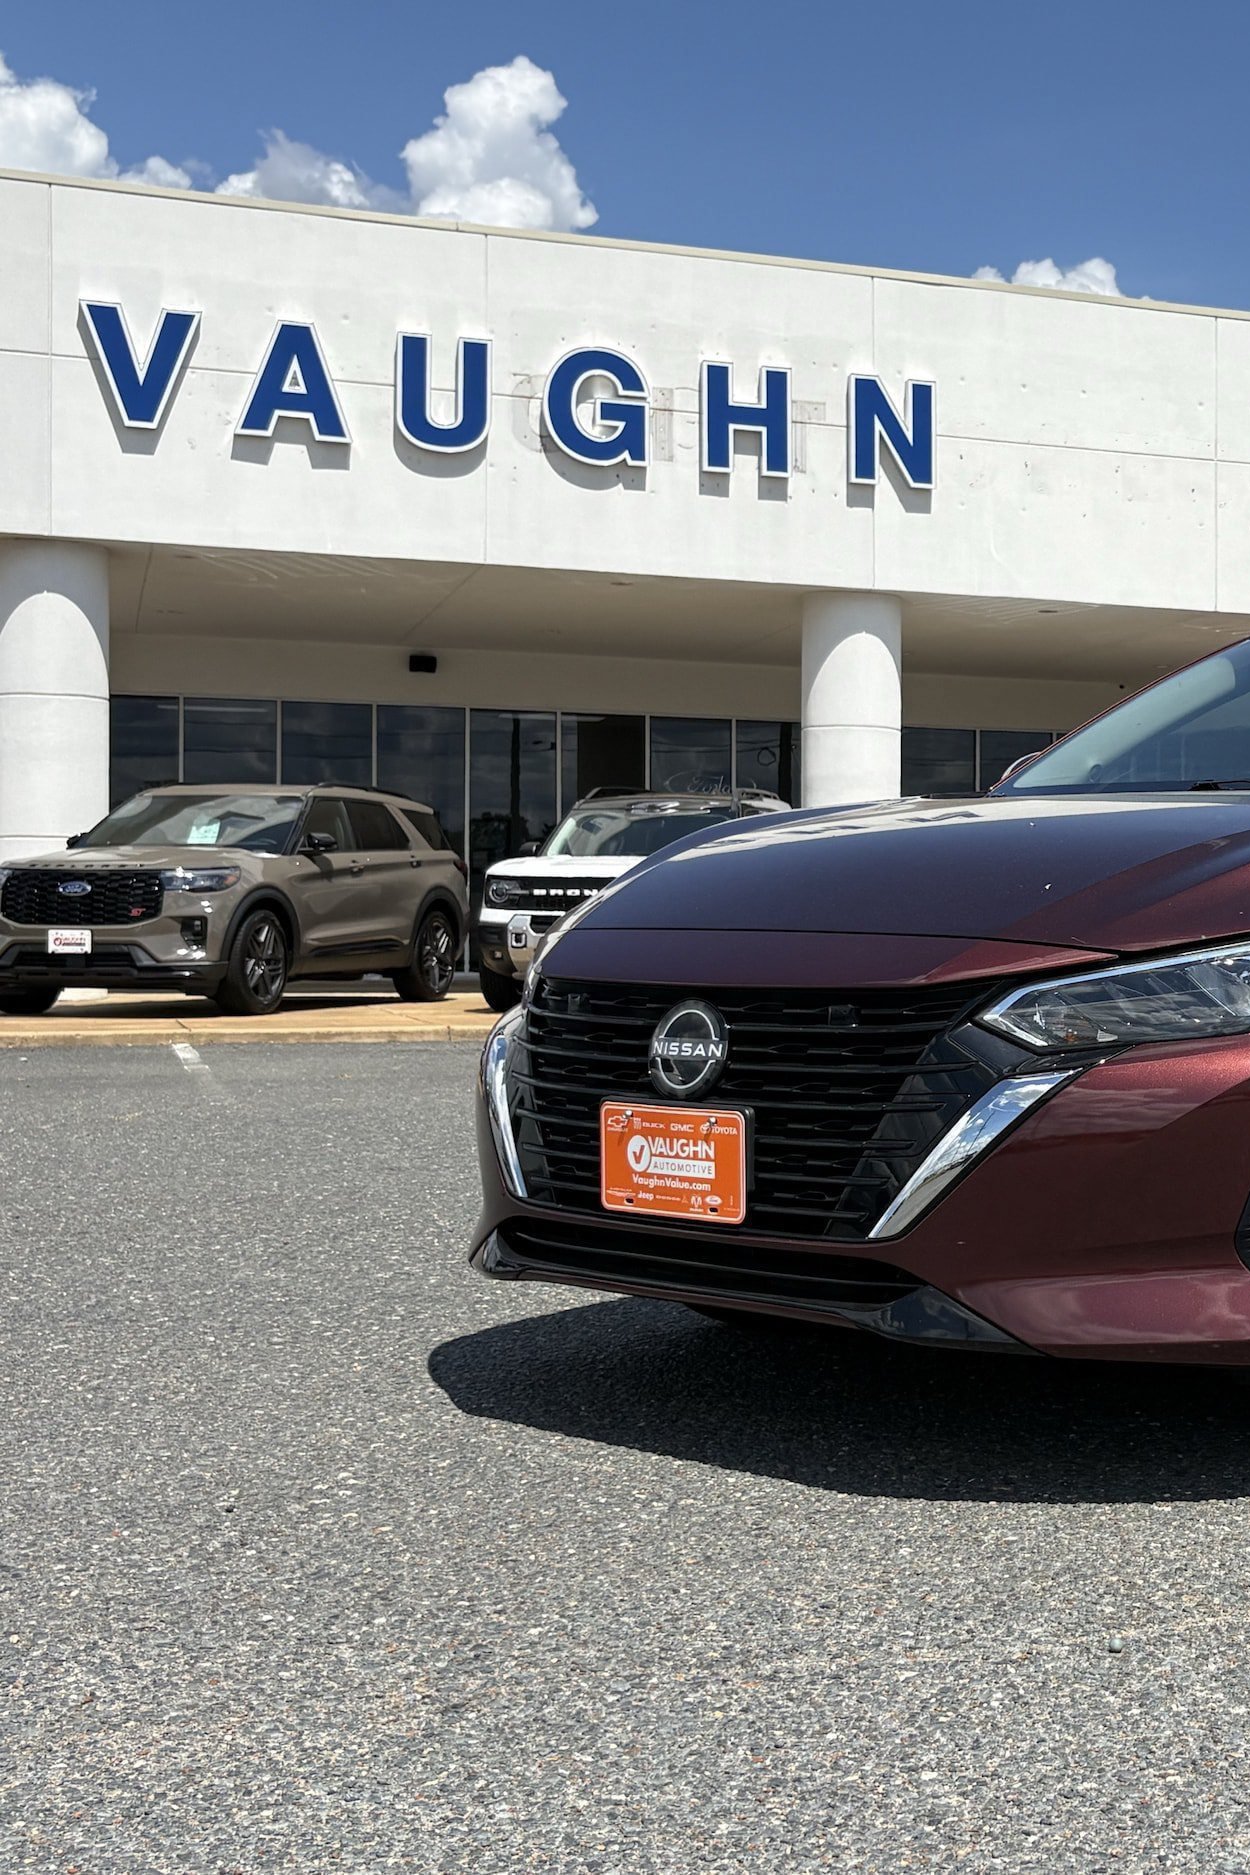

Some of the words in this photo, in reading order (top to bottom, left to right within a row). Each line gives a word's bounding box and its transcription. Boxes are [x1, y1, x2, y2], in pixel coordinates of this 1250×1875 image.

[79, 299, 936, 489] VAUGHN
[653, 1041, 723, 1057] NISSAN
[670, 1123, 695, 1132] GMC
[712, 1126, 738, 1135] TOYOTA
[648, 1135, 715, 1160] VAUGHN
[653, 1161, 713, 1175] AUTOMOTIVE
[632, 1173, 711, 1192] VaughnValue.com
[637, 1190, 654, 1201] Jeep
